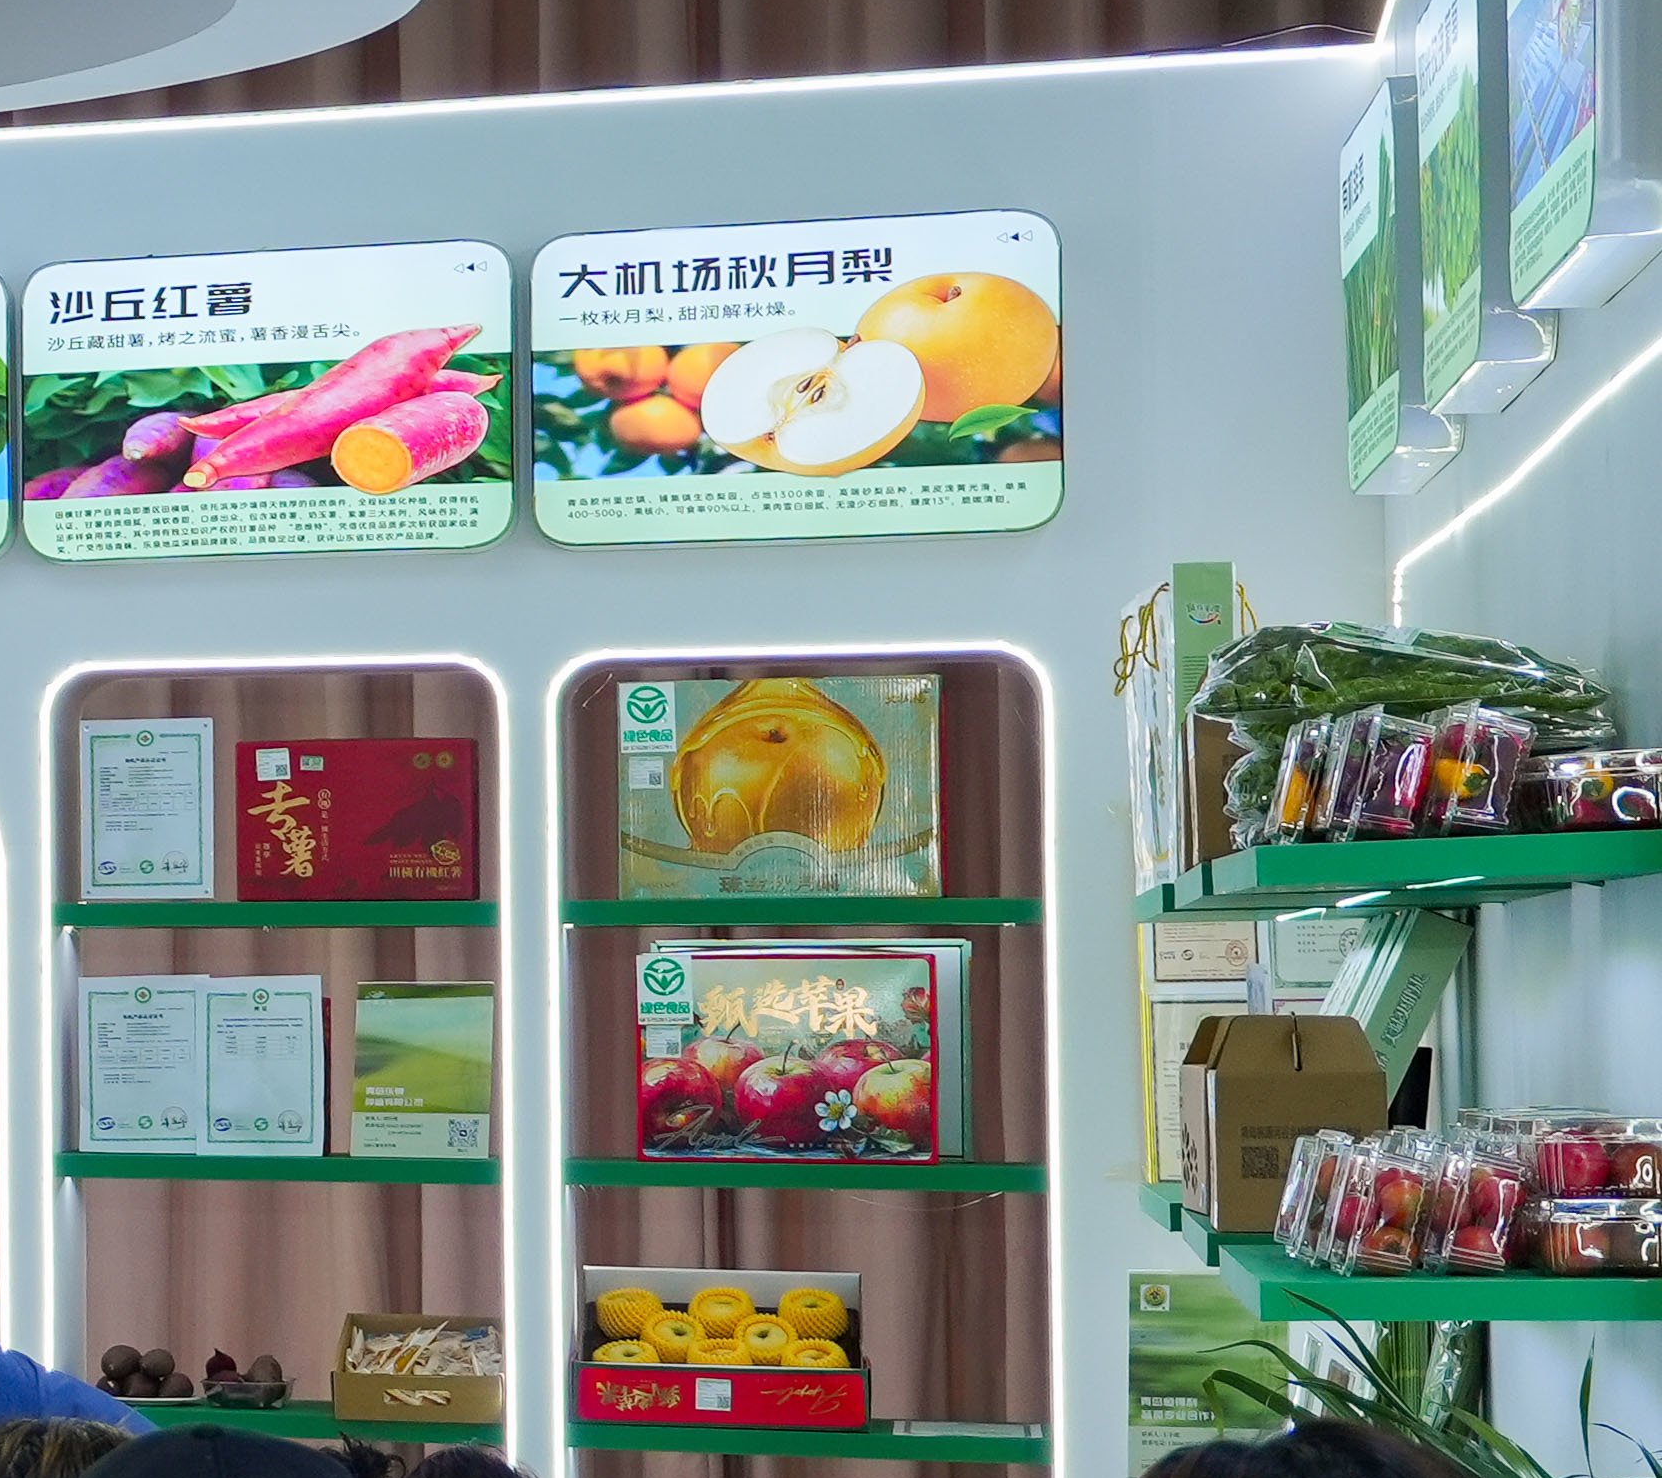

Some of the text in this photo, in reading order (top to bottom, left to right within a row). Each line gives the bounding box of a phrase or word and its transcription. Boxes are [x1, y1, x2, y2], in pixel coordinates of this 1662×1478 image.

[558, 247, 894, 298] 大机场秋月梨
[49, 282, 253, 324] 沙丘红薯
[558, 301, 797, 327] 一枚秋月梨，甜润解秋燥。
